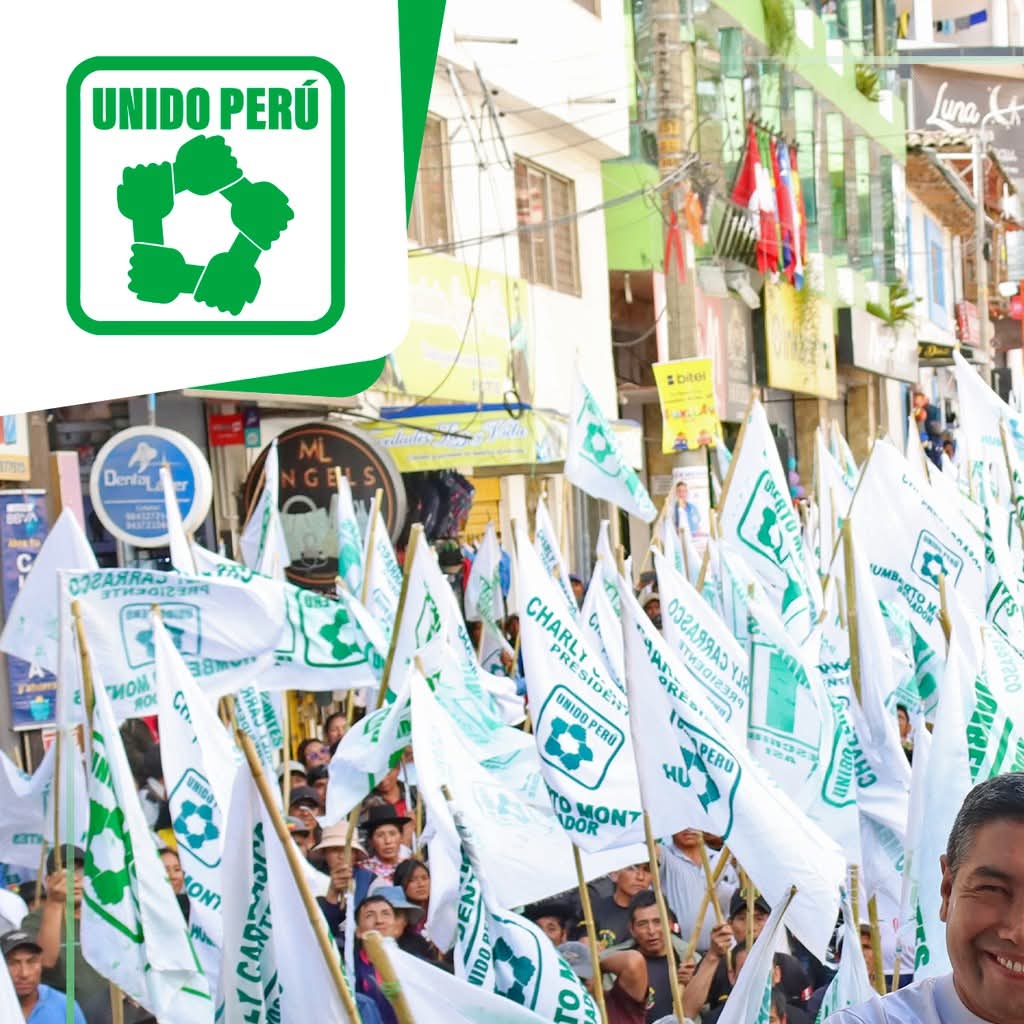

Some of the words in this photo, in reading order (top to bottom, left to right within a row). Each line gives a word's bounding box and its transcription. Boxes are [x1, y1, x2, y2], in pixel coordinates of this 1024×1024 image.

[926, 81, 980, 133] Luna
[676, 371, 706, 385] bitel
[526, 596, 588, 663] CHARLY
[556, 692, 590, 724] UNIDO
[588, 719, 618, 747] PERÚ
